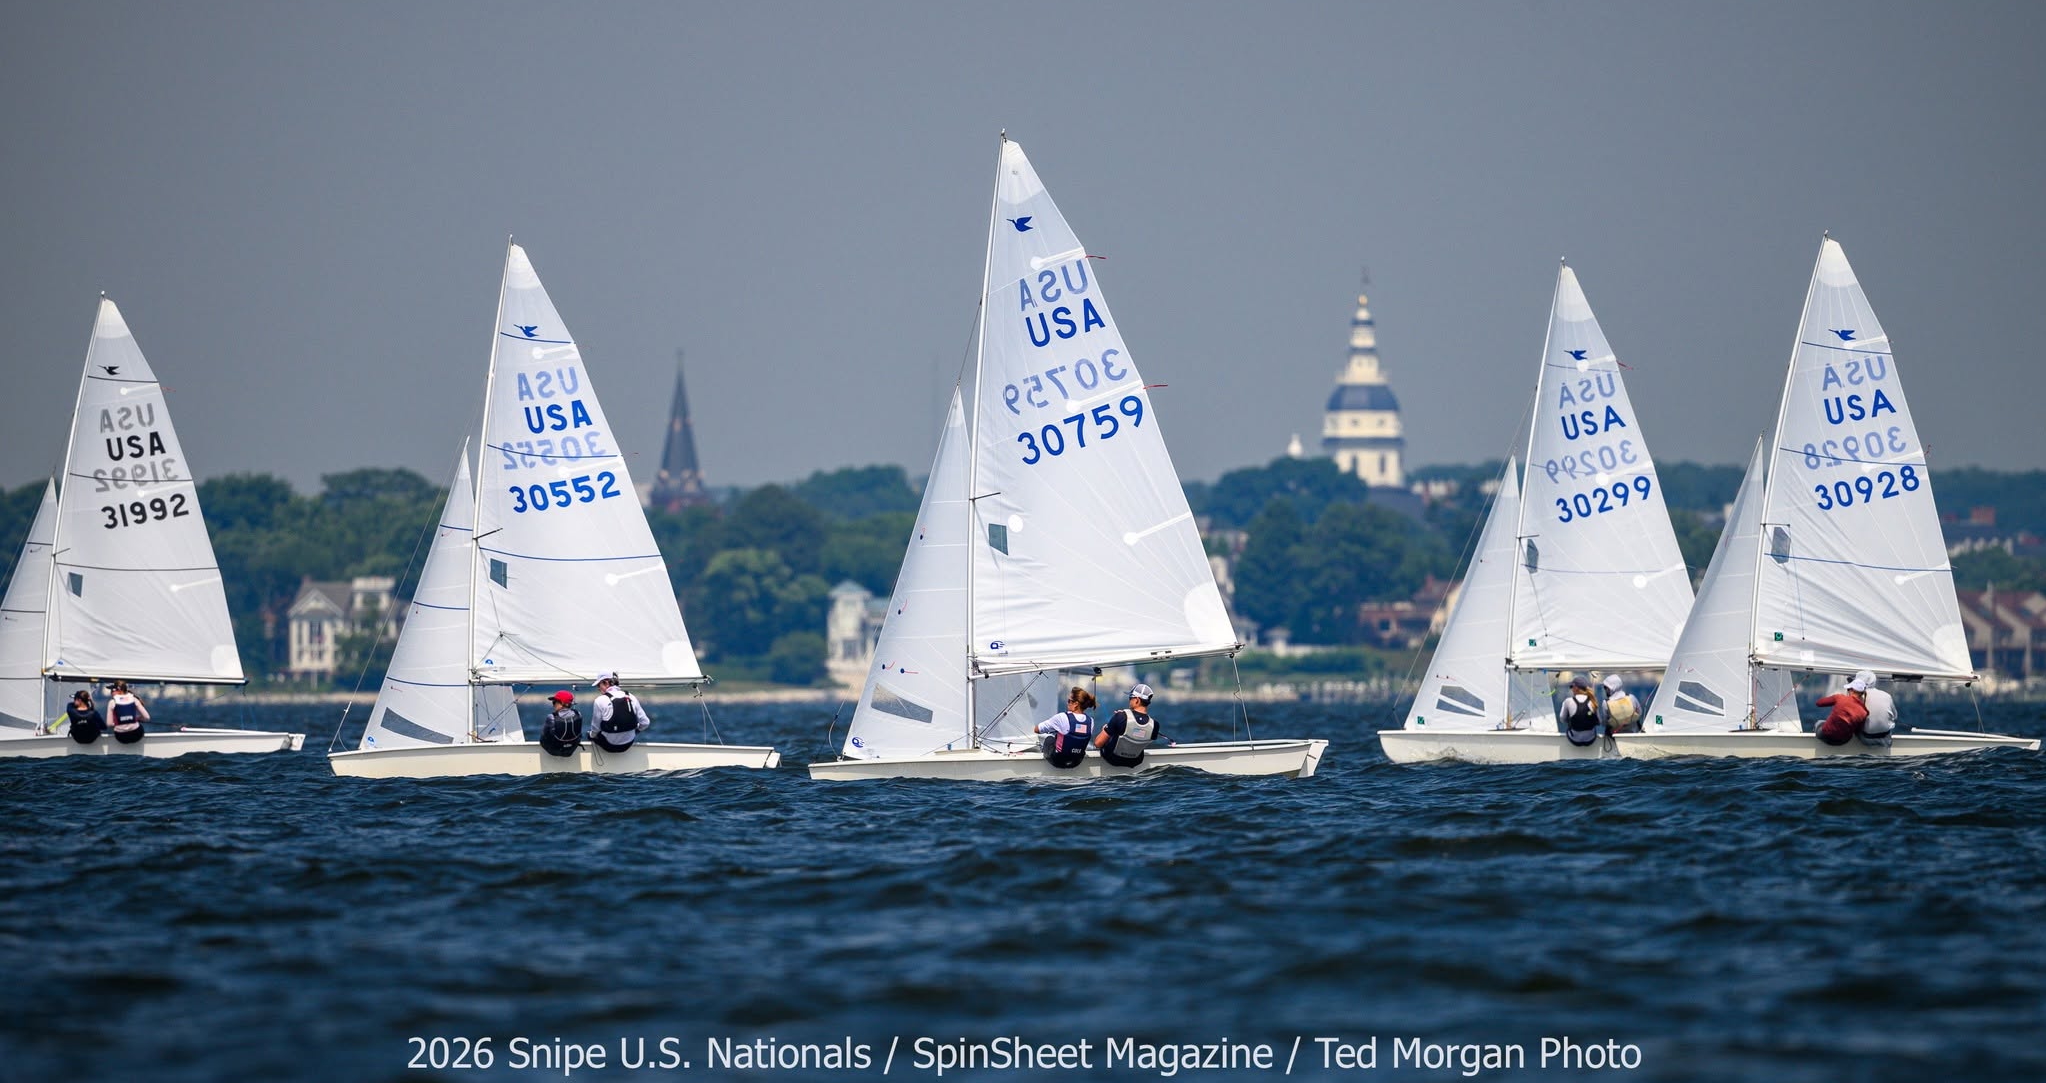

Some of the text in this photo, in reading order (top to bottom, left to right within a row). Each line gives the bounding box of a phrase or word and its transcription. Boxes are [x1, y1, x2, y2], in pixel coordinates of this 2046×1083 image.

[1025, 297, 1106, 348] USA
[524, 399, 593, 434] USA
[1560, 405, 1627, 441] USA
[1823, 388, 1897, 425] USA
[106, 431, 167, 462] USA
[1017, 395, 1144, 465] 30759
[508, 471, 621, 514] 30552
[1555, 475, 1651, 523] 30299
[1814, 464, 1920, 511] 30928
[101, 493, 190, 530] 31992
